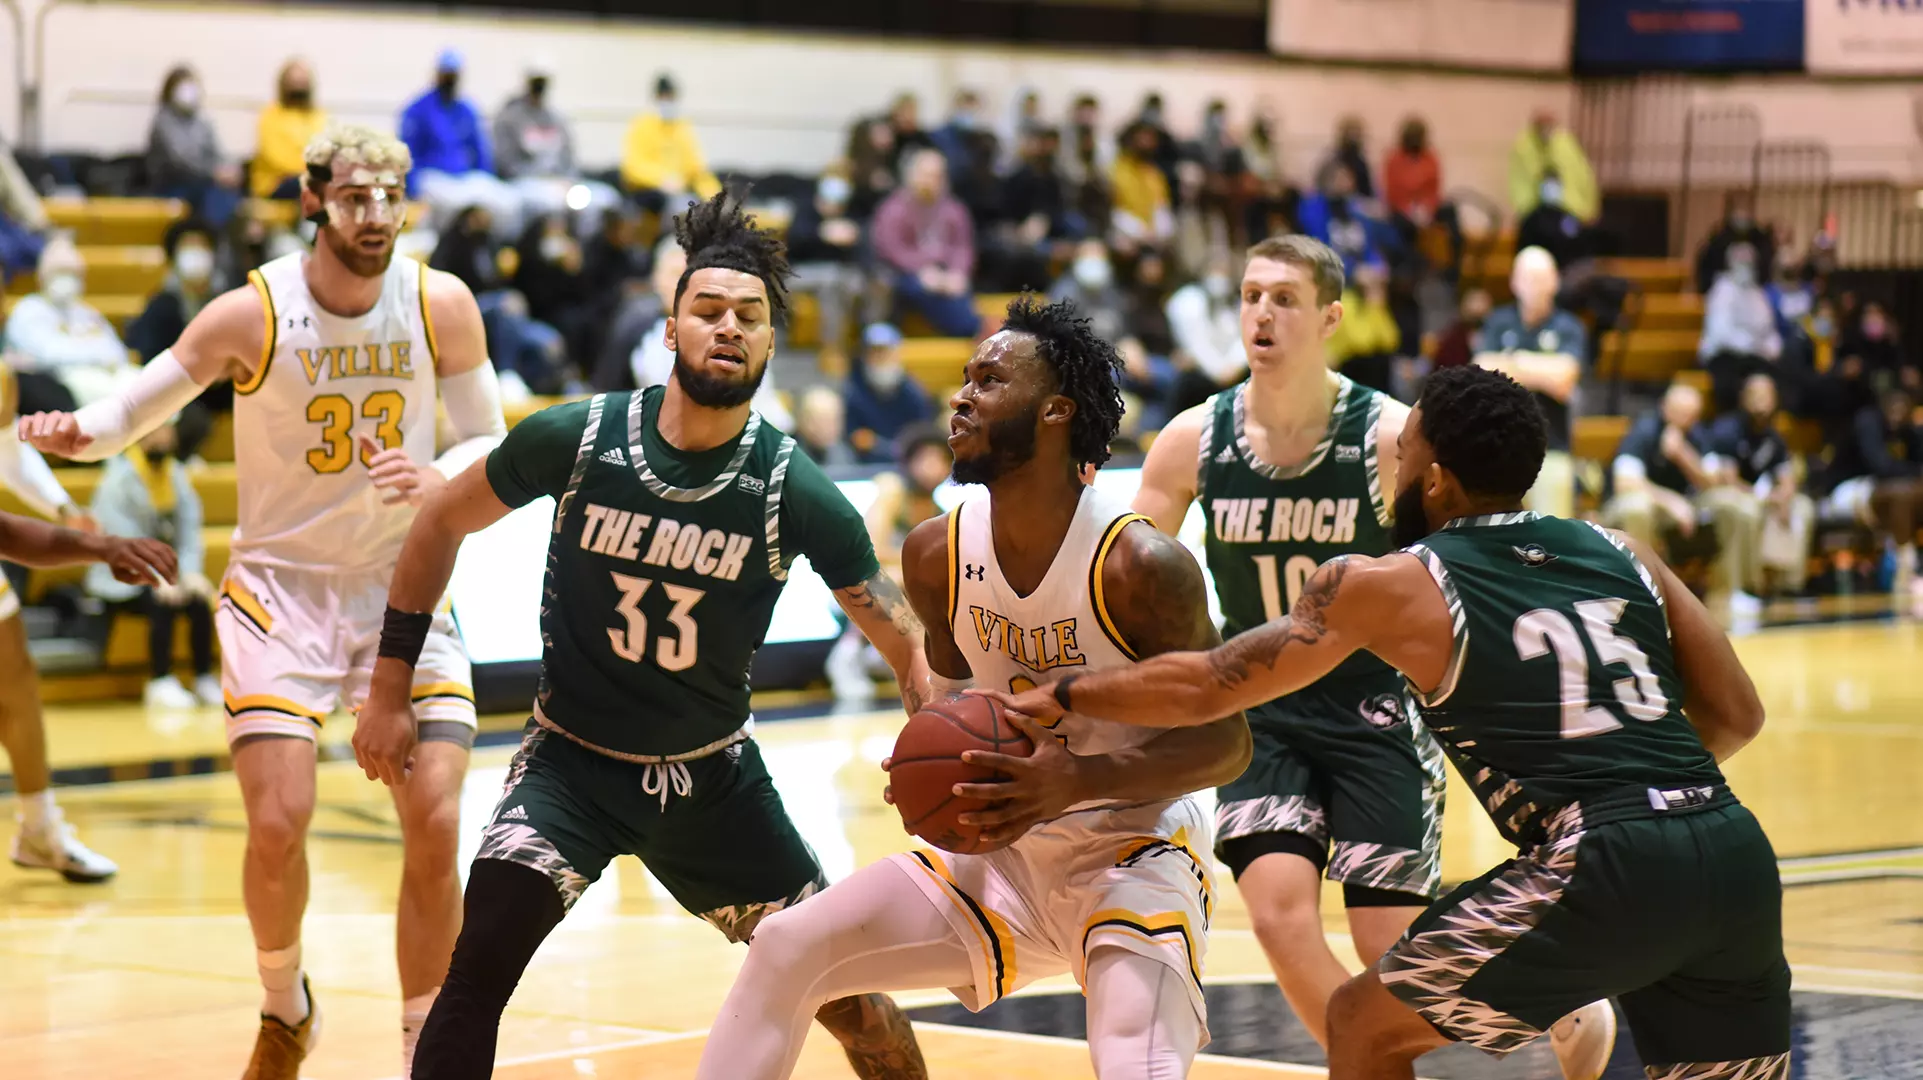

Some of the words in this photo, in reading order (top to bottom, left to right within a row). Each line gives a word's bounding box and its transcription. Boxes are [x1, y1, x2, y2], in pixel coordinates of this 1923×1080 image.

[295, 341, 415, 386] VILLE
[306, 389, 406, 474] 33
[599, 455, 627, 466] adidas
[740, 479, 764, 491] PSAC
[579, 503, 653, 561] THE
[641, 517, 753, 581] ROCK
[1211, 497, 1268, 543] THE
[1267, 497, 1359, 543] ROCK
[606, 570, 706, 672] 33
[969, 605, 1087, 673] VILLE
[1512, 597, 1669, 739] 25
